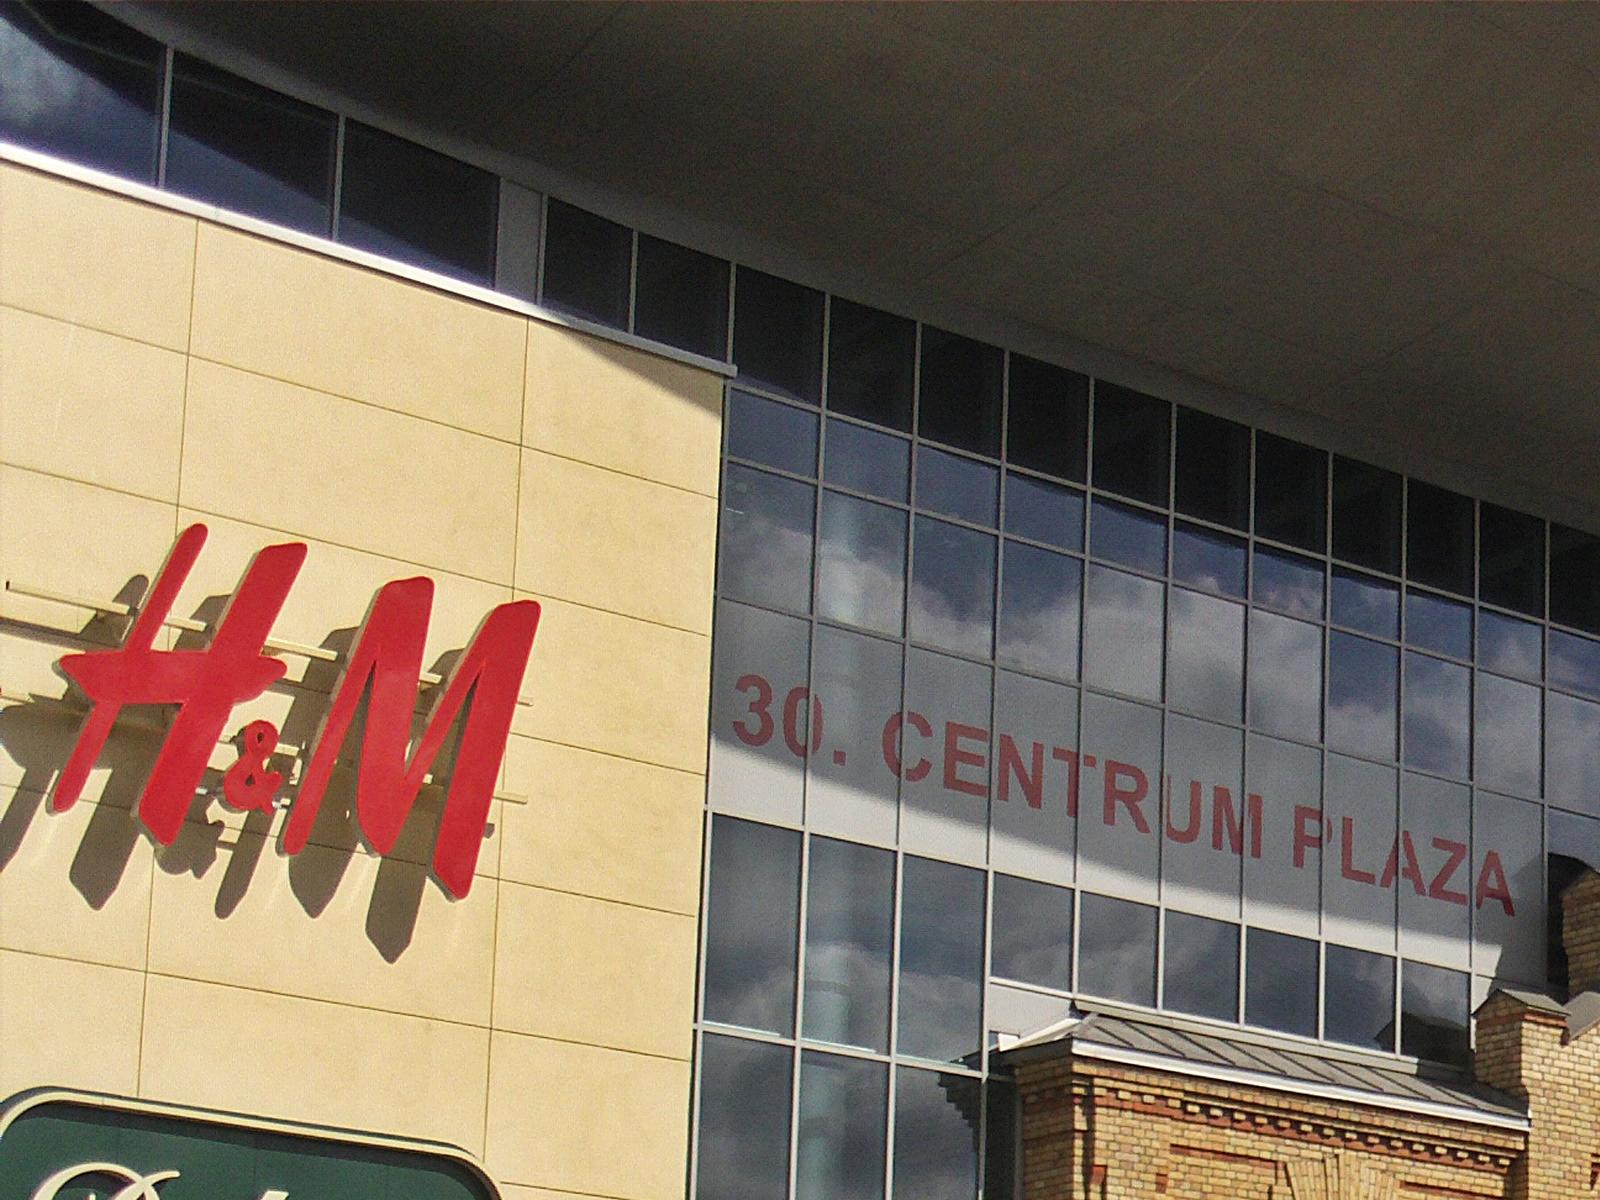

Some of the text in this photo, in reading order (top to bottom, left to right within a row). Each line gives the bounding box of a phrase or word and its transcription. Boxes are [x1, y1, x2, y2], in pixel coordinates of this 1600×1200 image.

[48, 522, 541, 901] H&M
[731, 674, 1516, 917] 30. CENTRUM PLAZA
